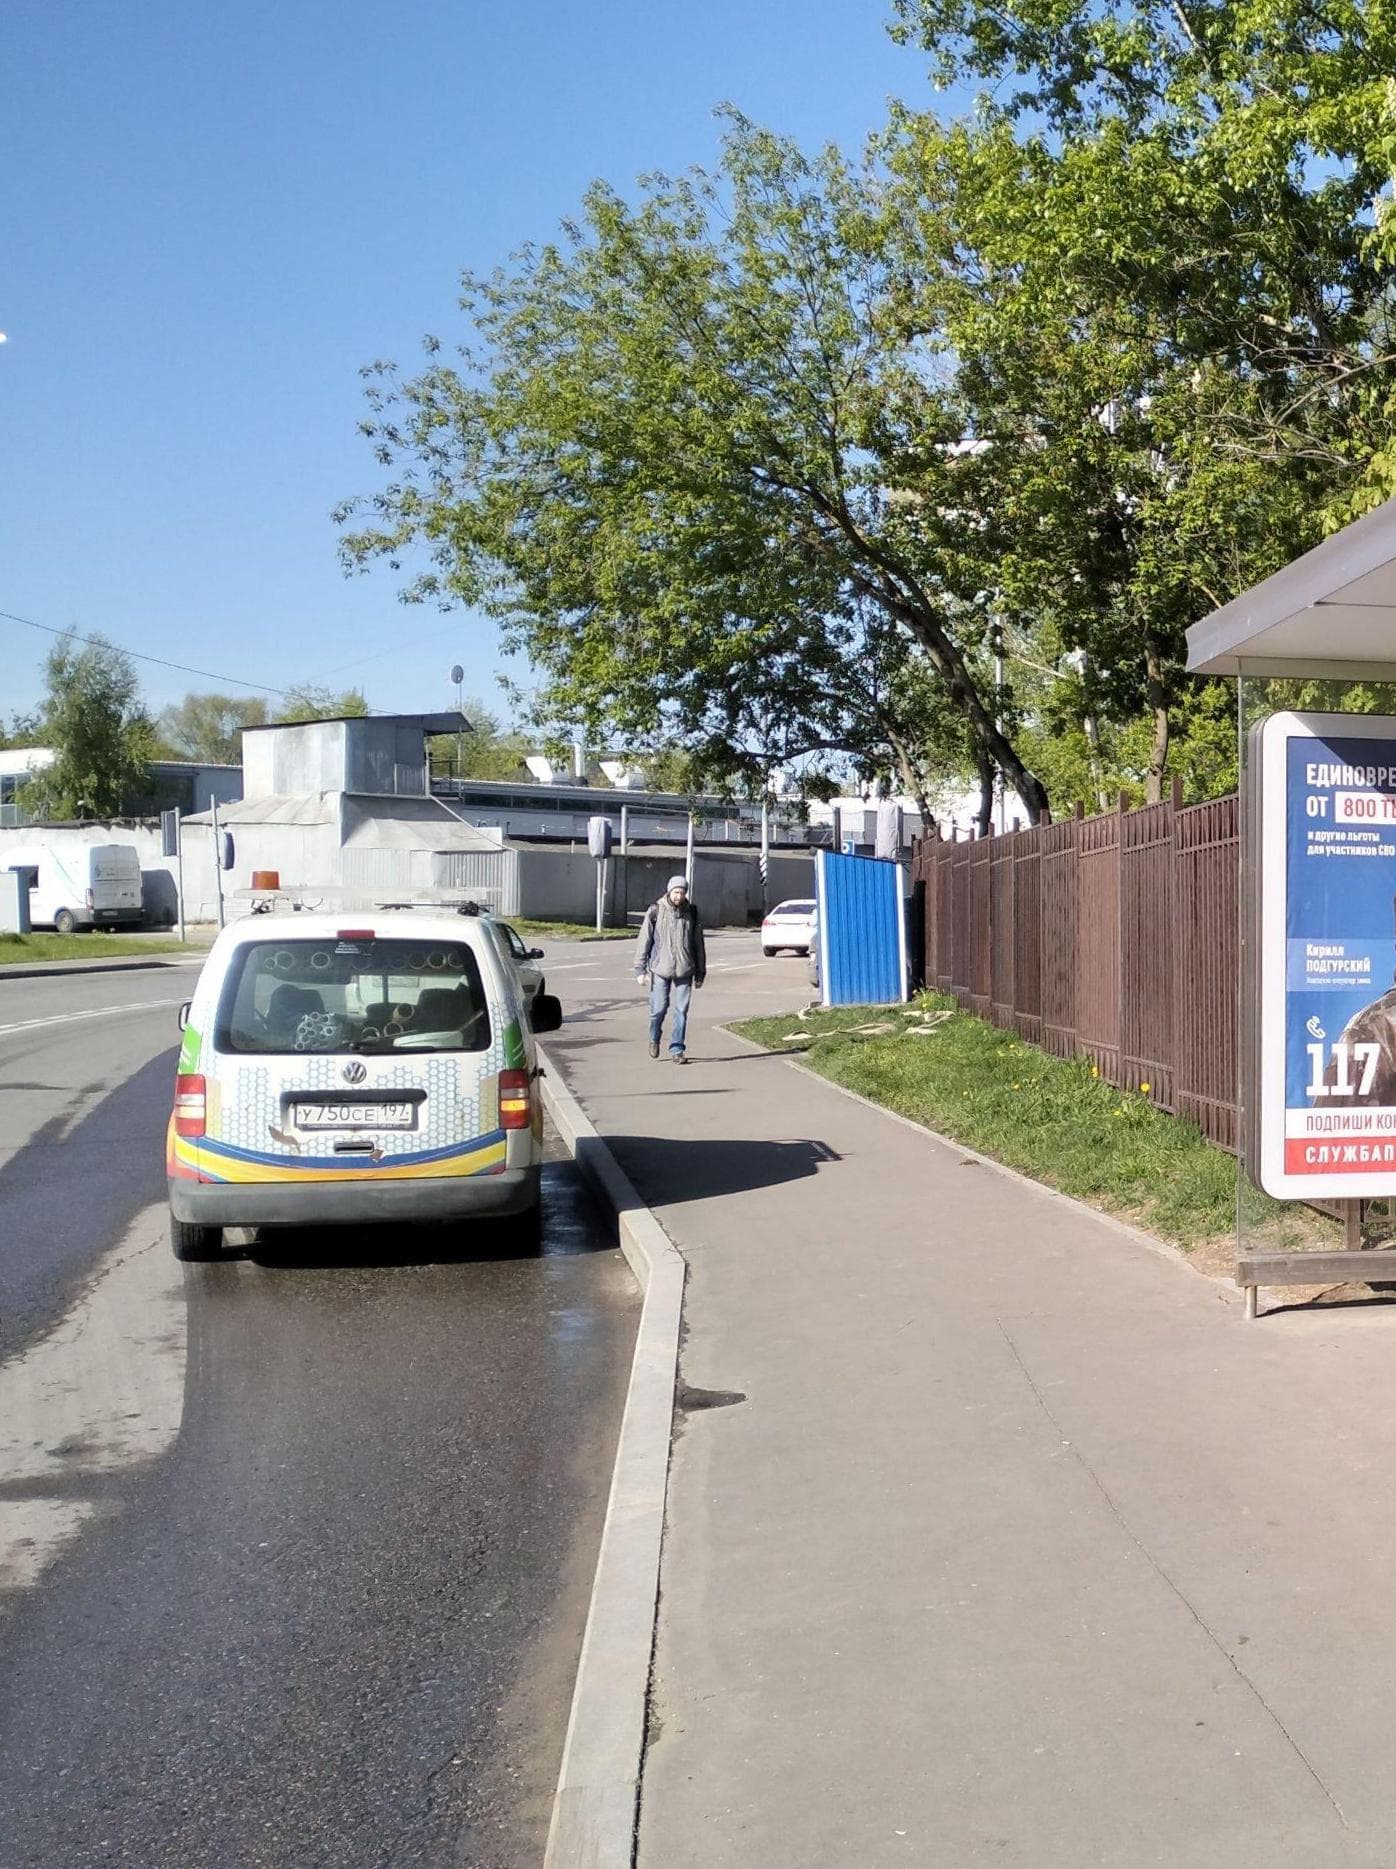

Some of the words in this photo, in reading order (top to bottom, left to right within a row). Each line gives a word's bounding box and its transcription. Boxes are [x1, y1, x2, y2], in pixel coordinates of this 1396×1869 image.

[1306, 796, 1329, 817] ОТ
[1343, 799, 1376, 818] 800
[1307, 831, 1314, 841] и
[1315, 831, 1346, 843] другие
[1347, 832, 1380, 842] льготы
[1307, 845, 1324, 856] для
[1325, 845, 1377, 857] участников
[1306, 943, 1345, 958] Кирилл
[1306, 957, 1371, 974] ПОДГУРСКИЙ
[1306, 1043, 1381, 1096] 117
[381, 1104, 407, 1117] 197
[1306, 1114, 1373, 1132] ПОДПИШИ
